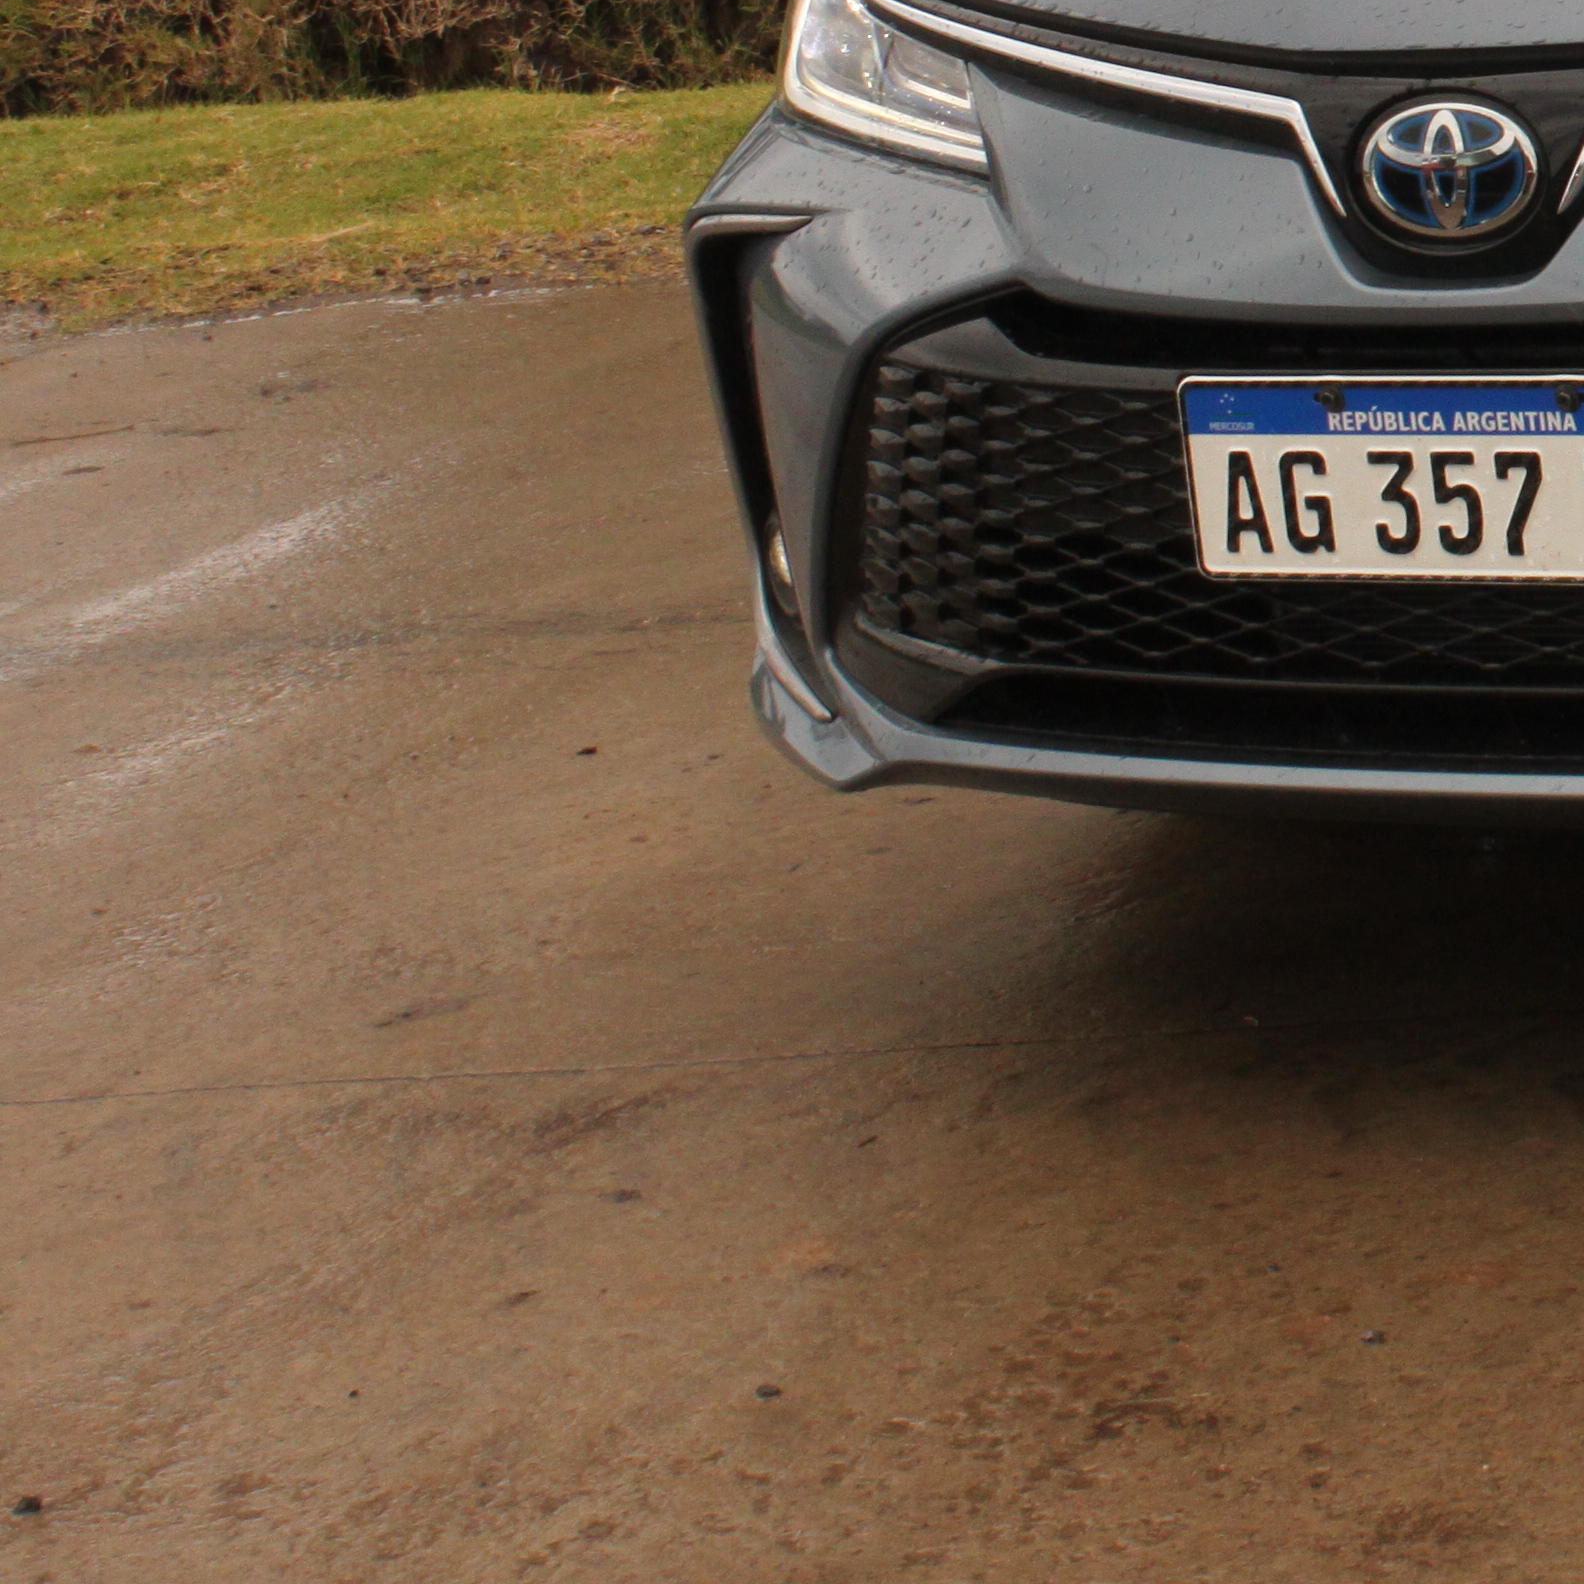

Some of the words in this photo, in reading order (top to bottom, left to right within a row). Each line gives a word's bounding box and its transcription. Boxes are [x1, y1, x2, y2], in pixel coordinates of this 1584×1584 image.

[1209, 421, 1255, 432] MERCOSUR
[1328, 405, 1446, 432] REPÚBLICA
[1453, 410, 1577, 432] ARGENTINA
[1226, 450, 1336, 554] AG
[1366, 450, 1543, 556] 357
